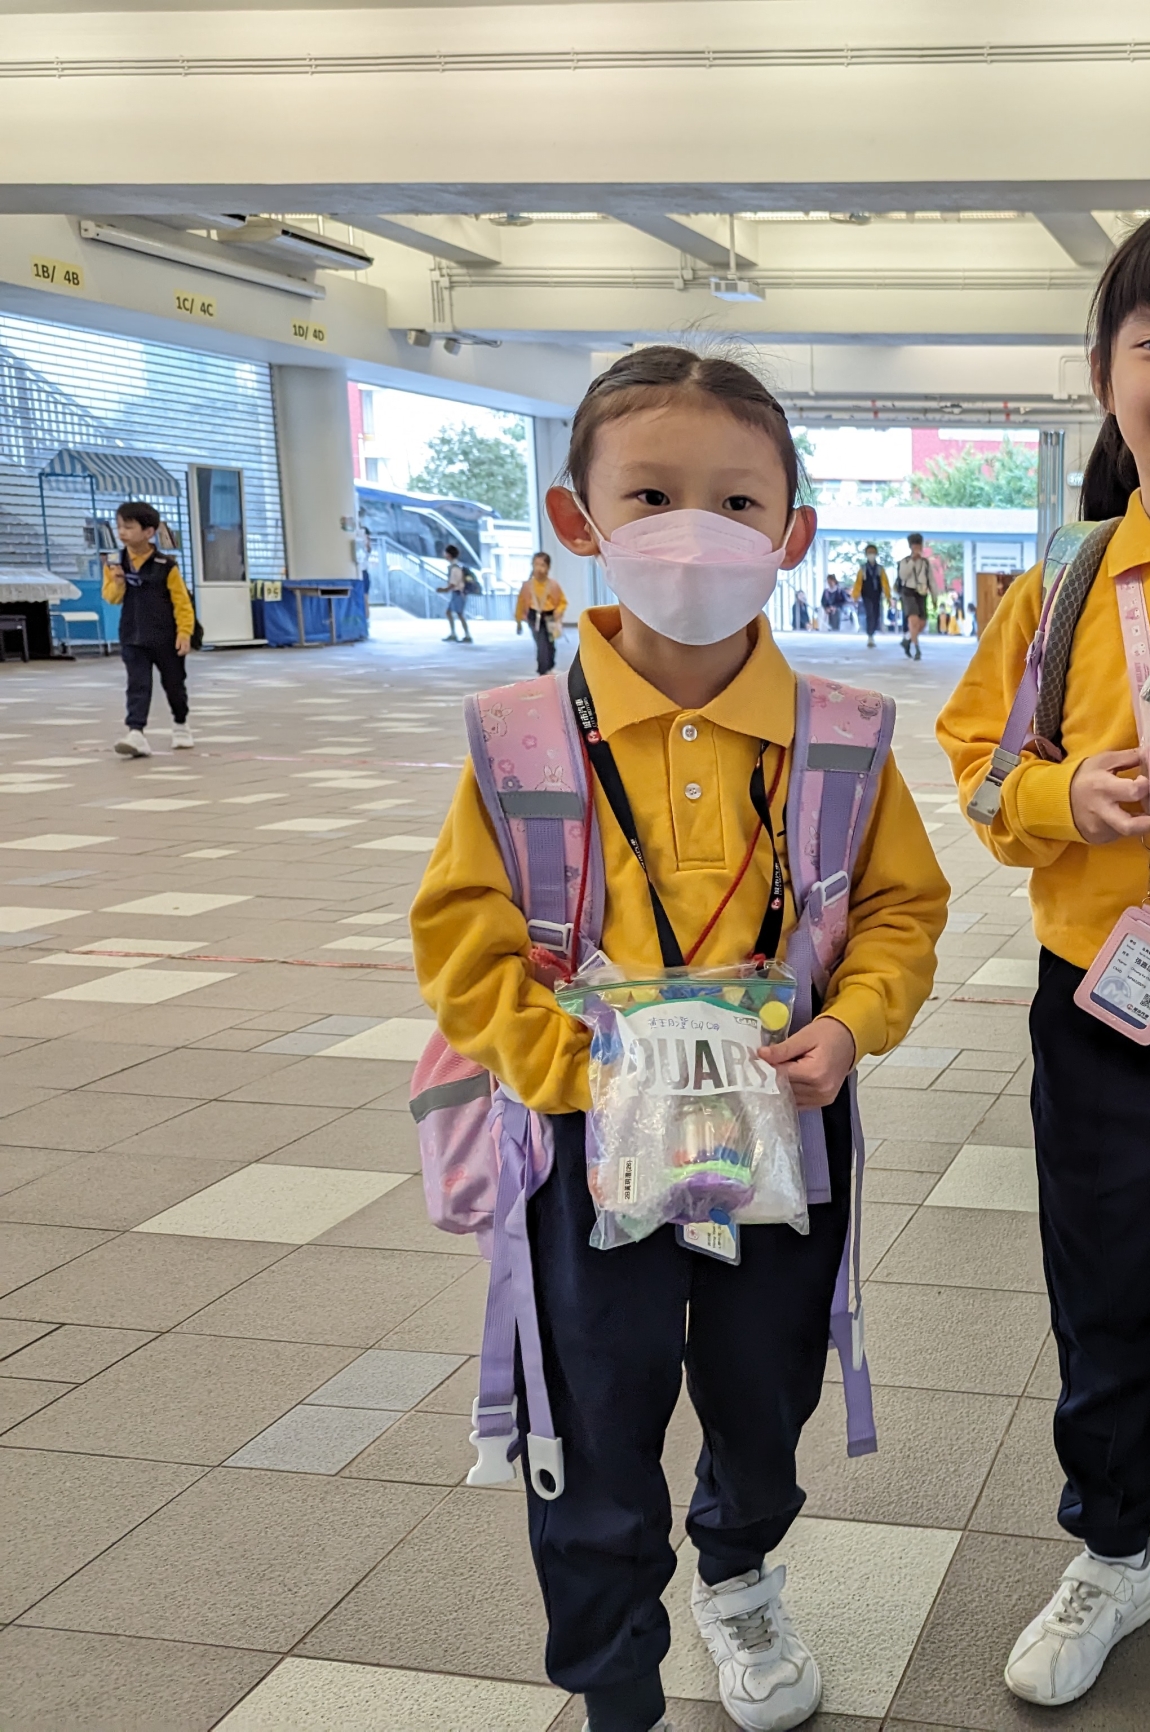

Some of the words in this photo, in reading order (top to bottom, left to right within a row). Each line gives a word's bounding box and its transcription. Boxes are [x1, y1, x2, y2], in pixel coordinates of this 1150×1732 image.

[33, 263, 56, 283] 1B/
[63, 270, 80, 286] 4B
[176, 296, 194, 315] 1C/
[200, 302, 214, 317] 4C
[293, 323, 309, 341] 1D/
[312, 328, 325, 341] 4D
